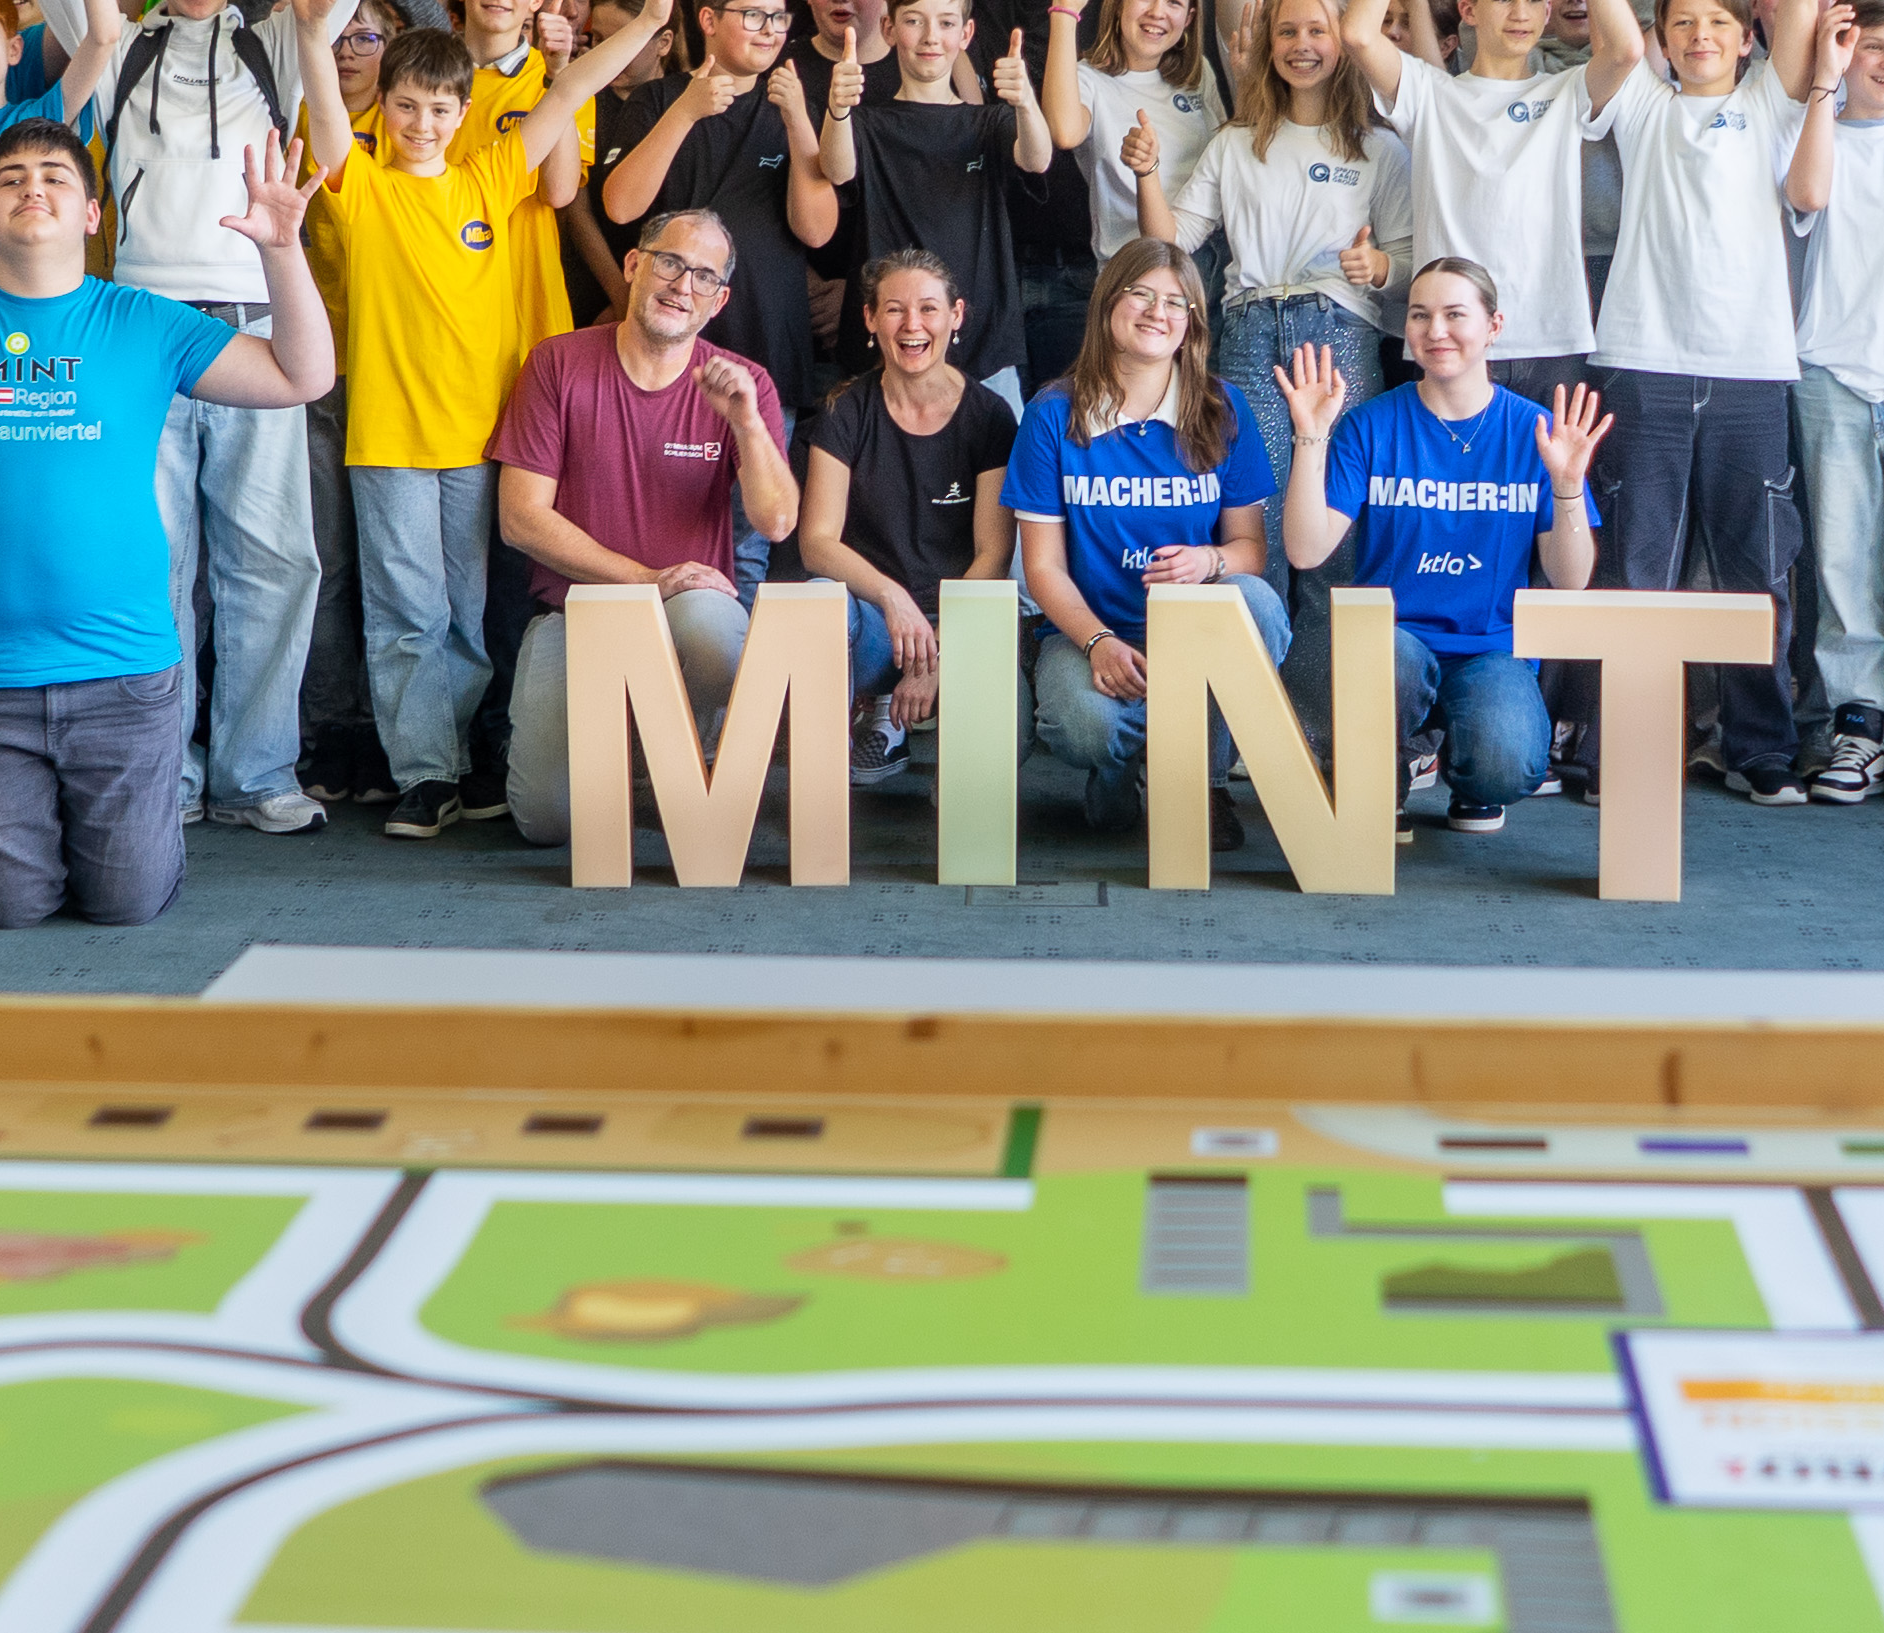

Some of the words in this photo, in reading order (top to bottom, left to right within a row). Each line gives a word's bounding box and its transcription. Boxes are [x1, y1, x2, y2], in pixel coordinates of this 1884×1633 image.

[15, 387, 77, 410] Region
[1368, 475, 1539, 514] MACHER:IN
[564, 579, 1775, 903] MINT
